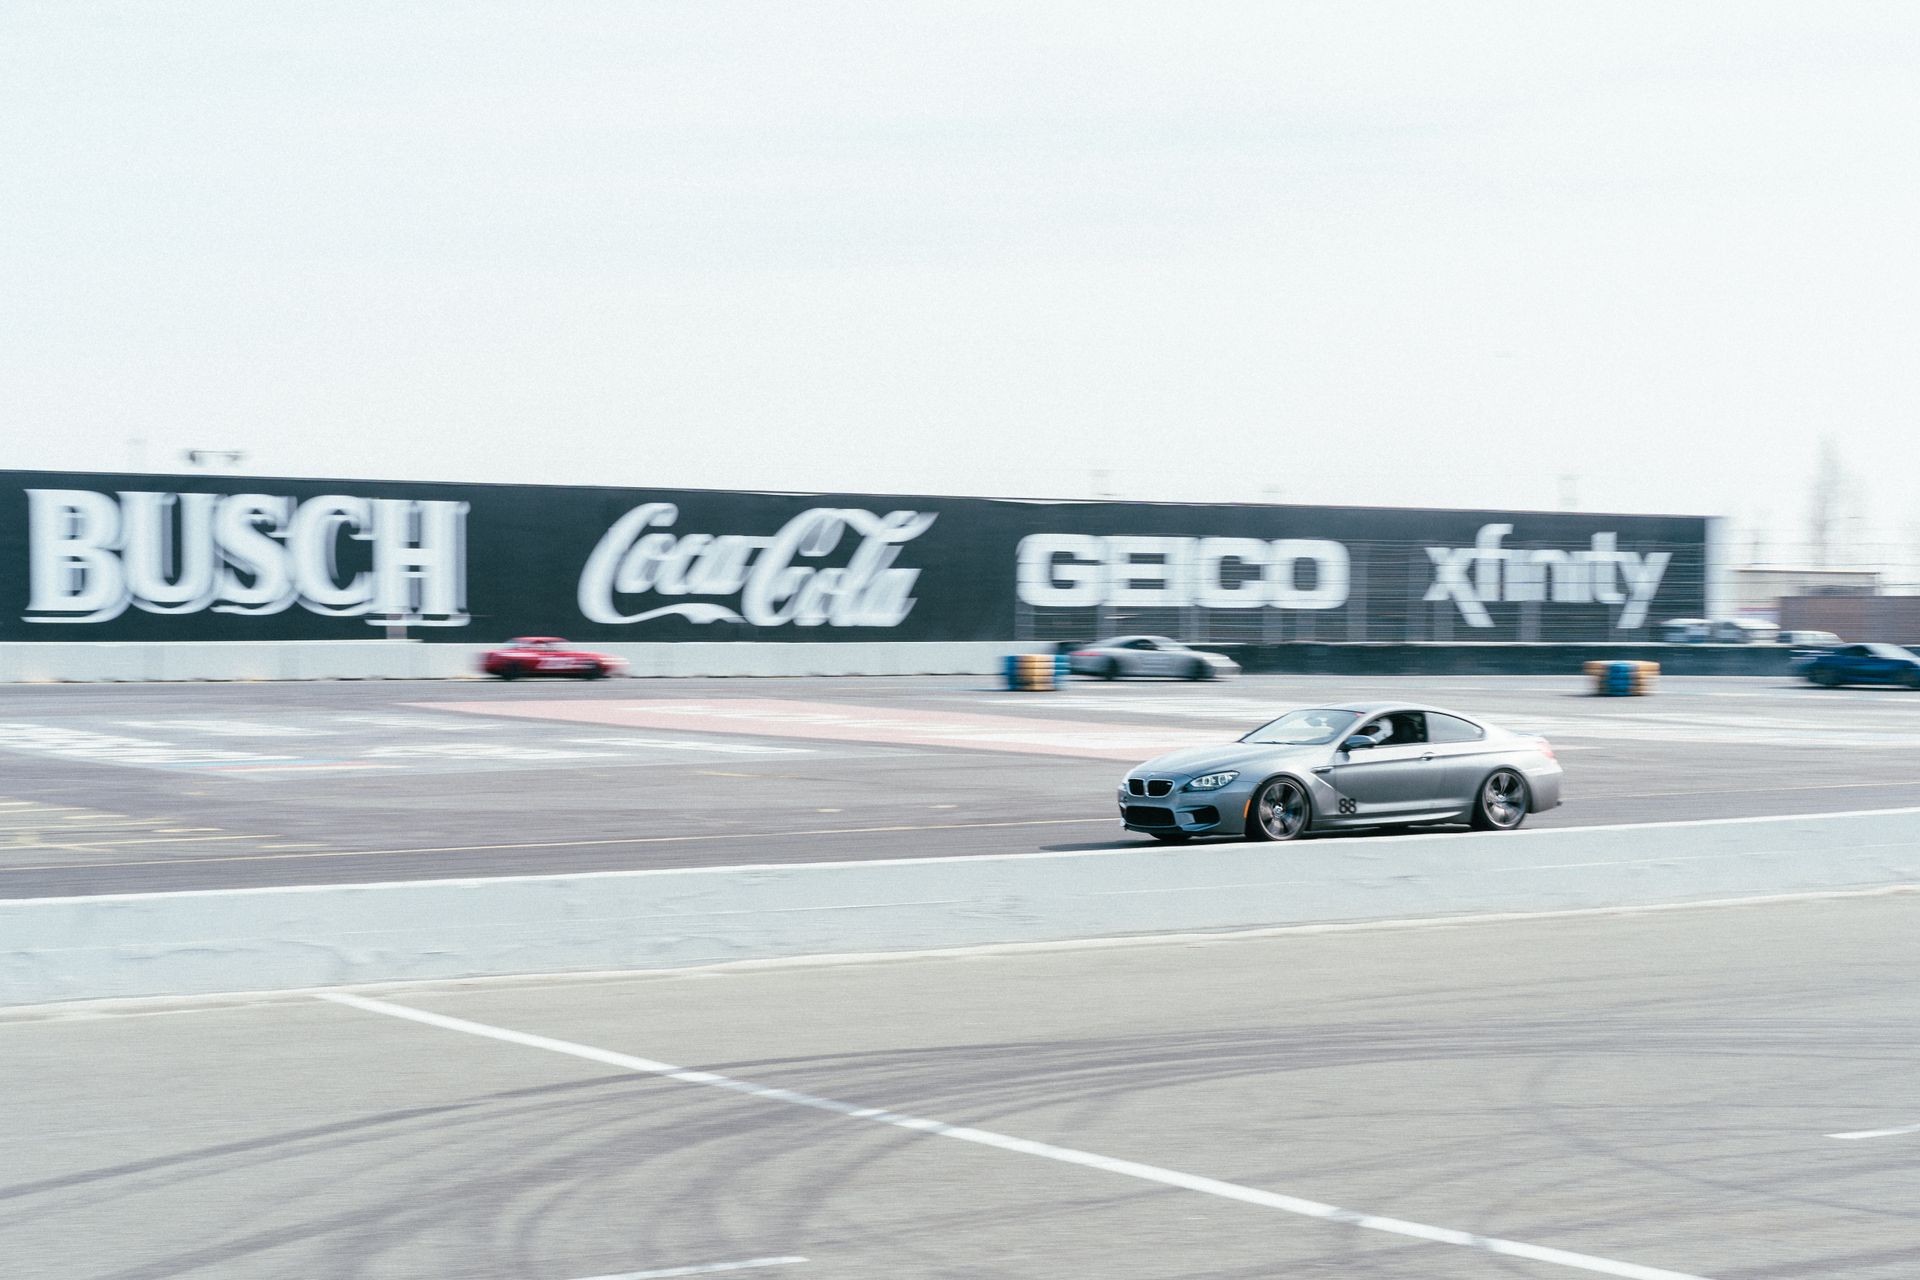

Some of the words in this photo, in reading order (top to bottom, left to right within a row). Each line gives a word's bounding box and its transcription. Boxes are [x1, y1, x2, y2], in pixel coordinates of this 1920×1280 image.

[23, 488, 470, 626] BUSCH
[1017, 533, 1350, 610] GEICO
[1423, 523, 1673, 629] xfinity
[1338, 797, 1357, 815] 88
